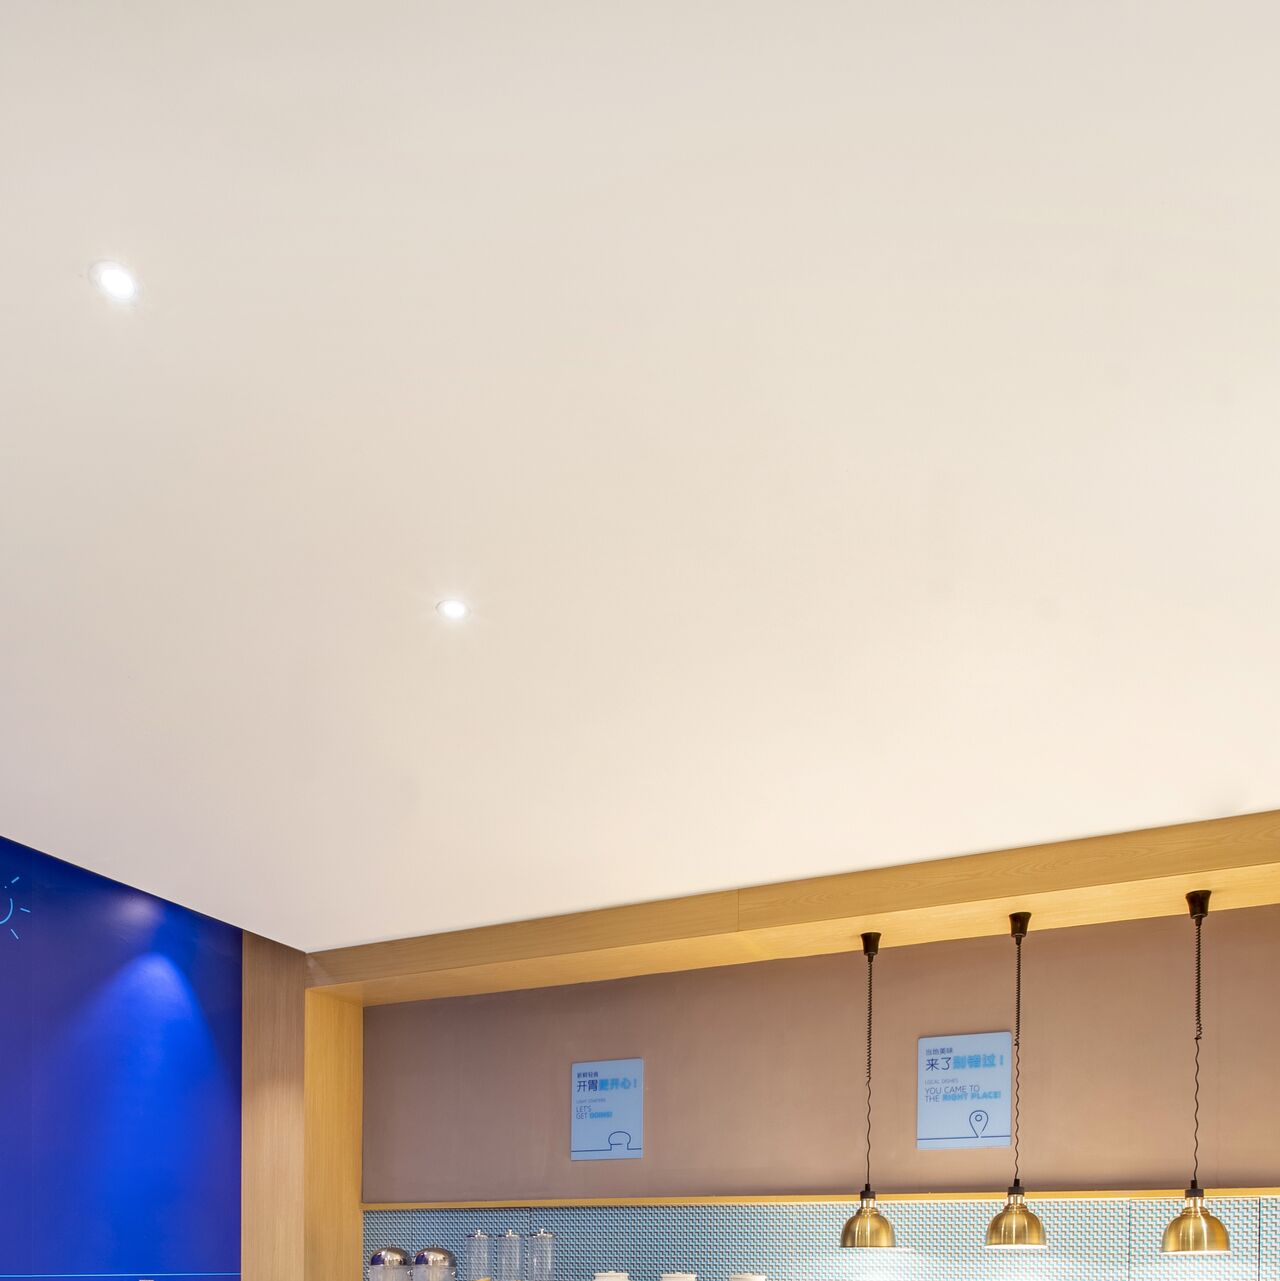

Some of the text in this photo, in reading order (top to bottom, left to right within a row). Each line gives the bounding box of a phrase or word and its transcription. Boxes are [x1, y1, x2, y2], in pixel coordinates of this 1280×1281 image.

[925, 1084, 980, 1095] YOU CAME TO
